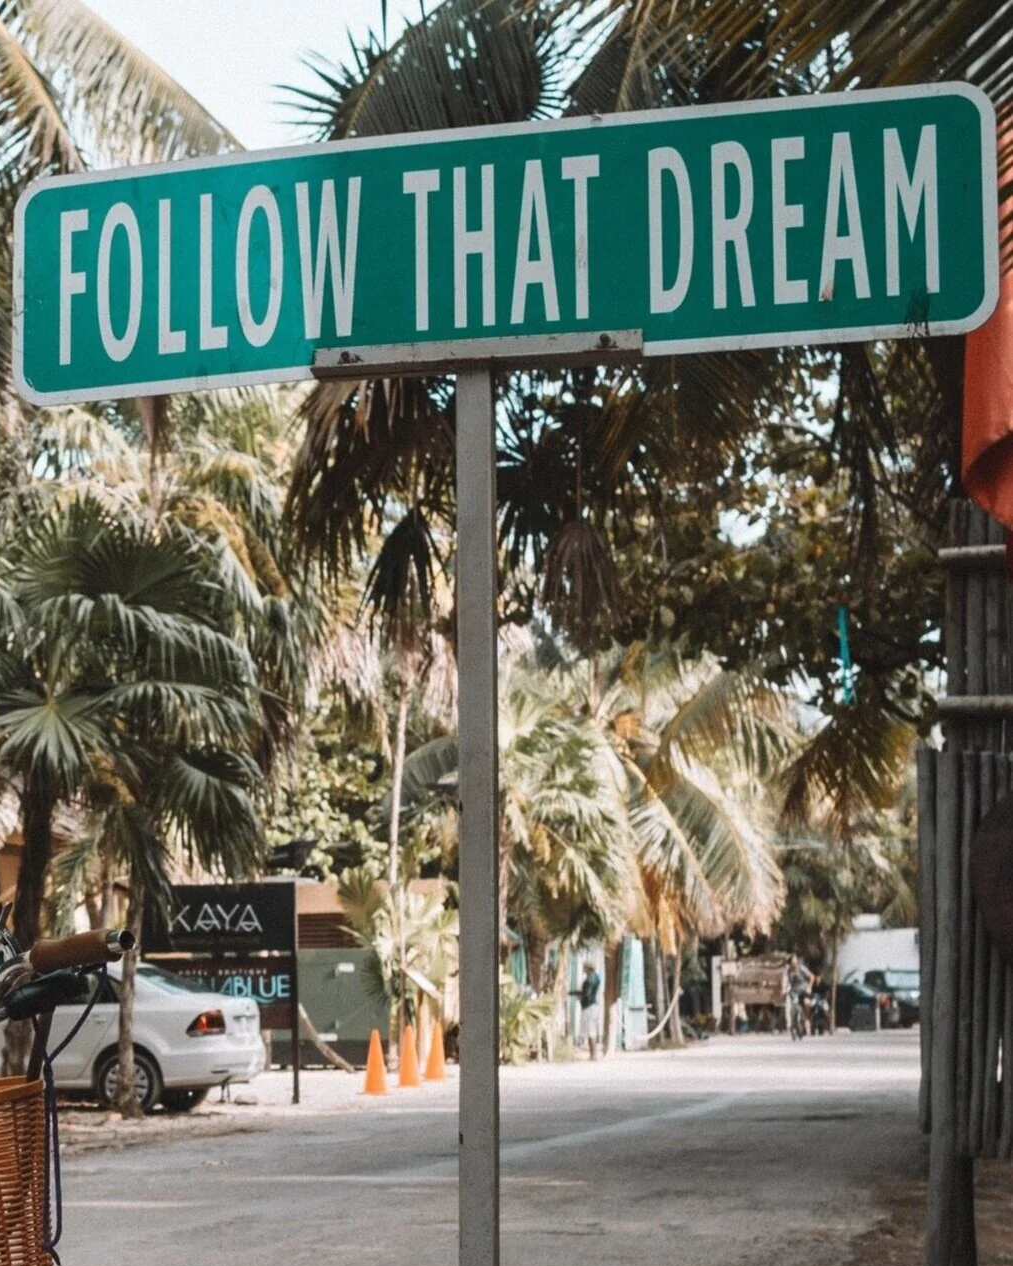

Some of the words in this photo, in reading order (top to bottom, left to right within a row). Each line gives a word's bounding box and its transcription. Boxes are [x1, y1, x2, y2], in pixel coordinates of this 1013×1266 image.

[59, 176, 362, 366] FOLLOW
[402, 153, 600, 331] THAT
[648, 123, 940, 313] DREAM
[168, 903, 263, 932] KAYA
